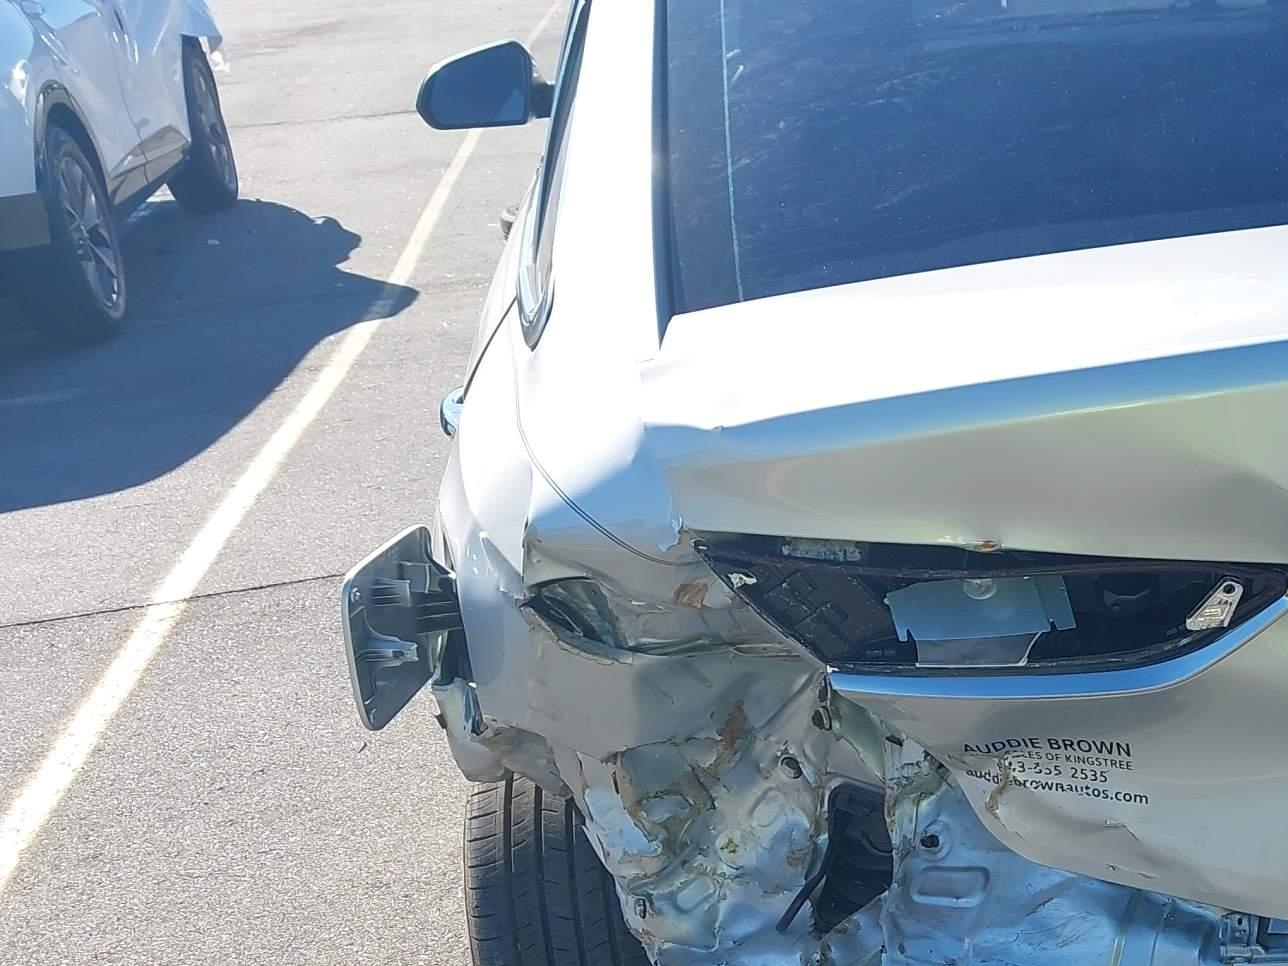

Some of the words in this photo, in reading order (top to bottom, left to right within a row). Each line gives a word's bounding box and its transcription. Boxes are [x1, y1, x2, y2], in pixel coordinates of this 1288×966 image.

[963, 738, 1043, 754] AUDDIE
[1047, 738, 1132, 757] BROWN
[1045, 752, 1062, 762] OF
[1065, 754, 1134, 771] KINGSTREE
[1070, 766, 1109, 783] 2535
[966, 769, 1149, 804] auddbrownautos.com
